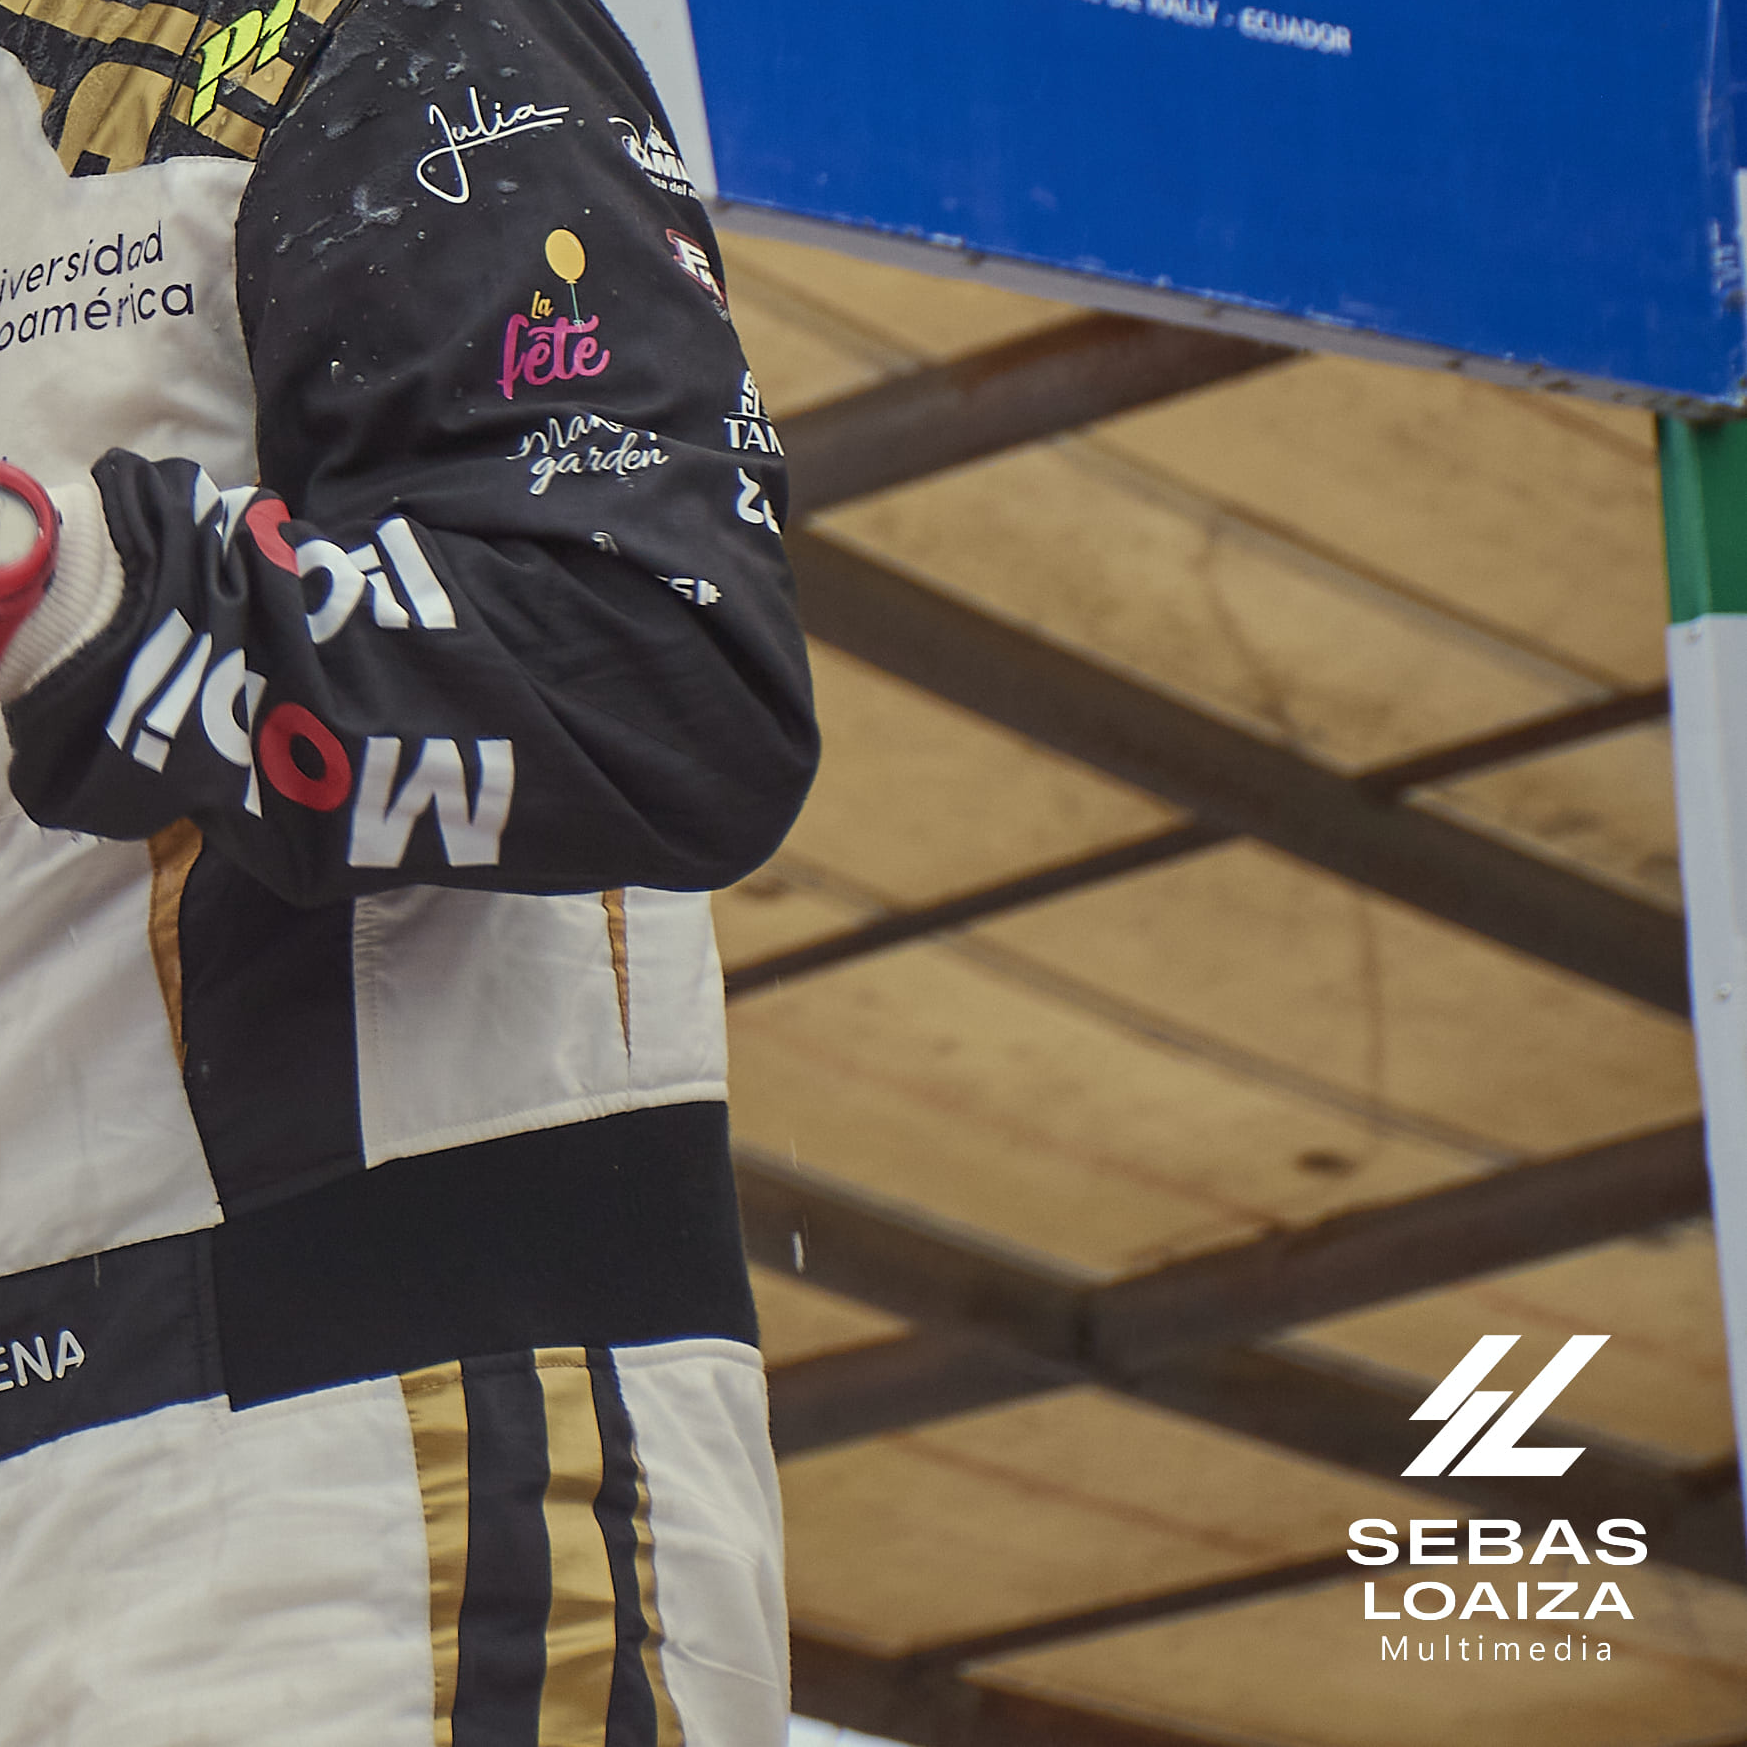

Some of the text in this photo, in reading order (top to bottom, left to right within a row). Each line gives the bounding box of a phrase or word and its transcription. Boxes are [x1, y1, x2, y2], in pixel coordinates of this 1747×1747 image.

[1238, 6, 1353, 55] ECUADOR
[416, 87, 569, 203] Julia
[497, 314, 610, 401] fête
[529, 431, 670, 496] garden
[105, 607, 515, 869] Mobil
